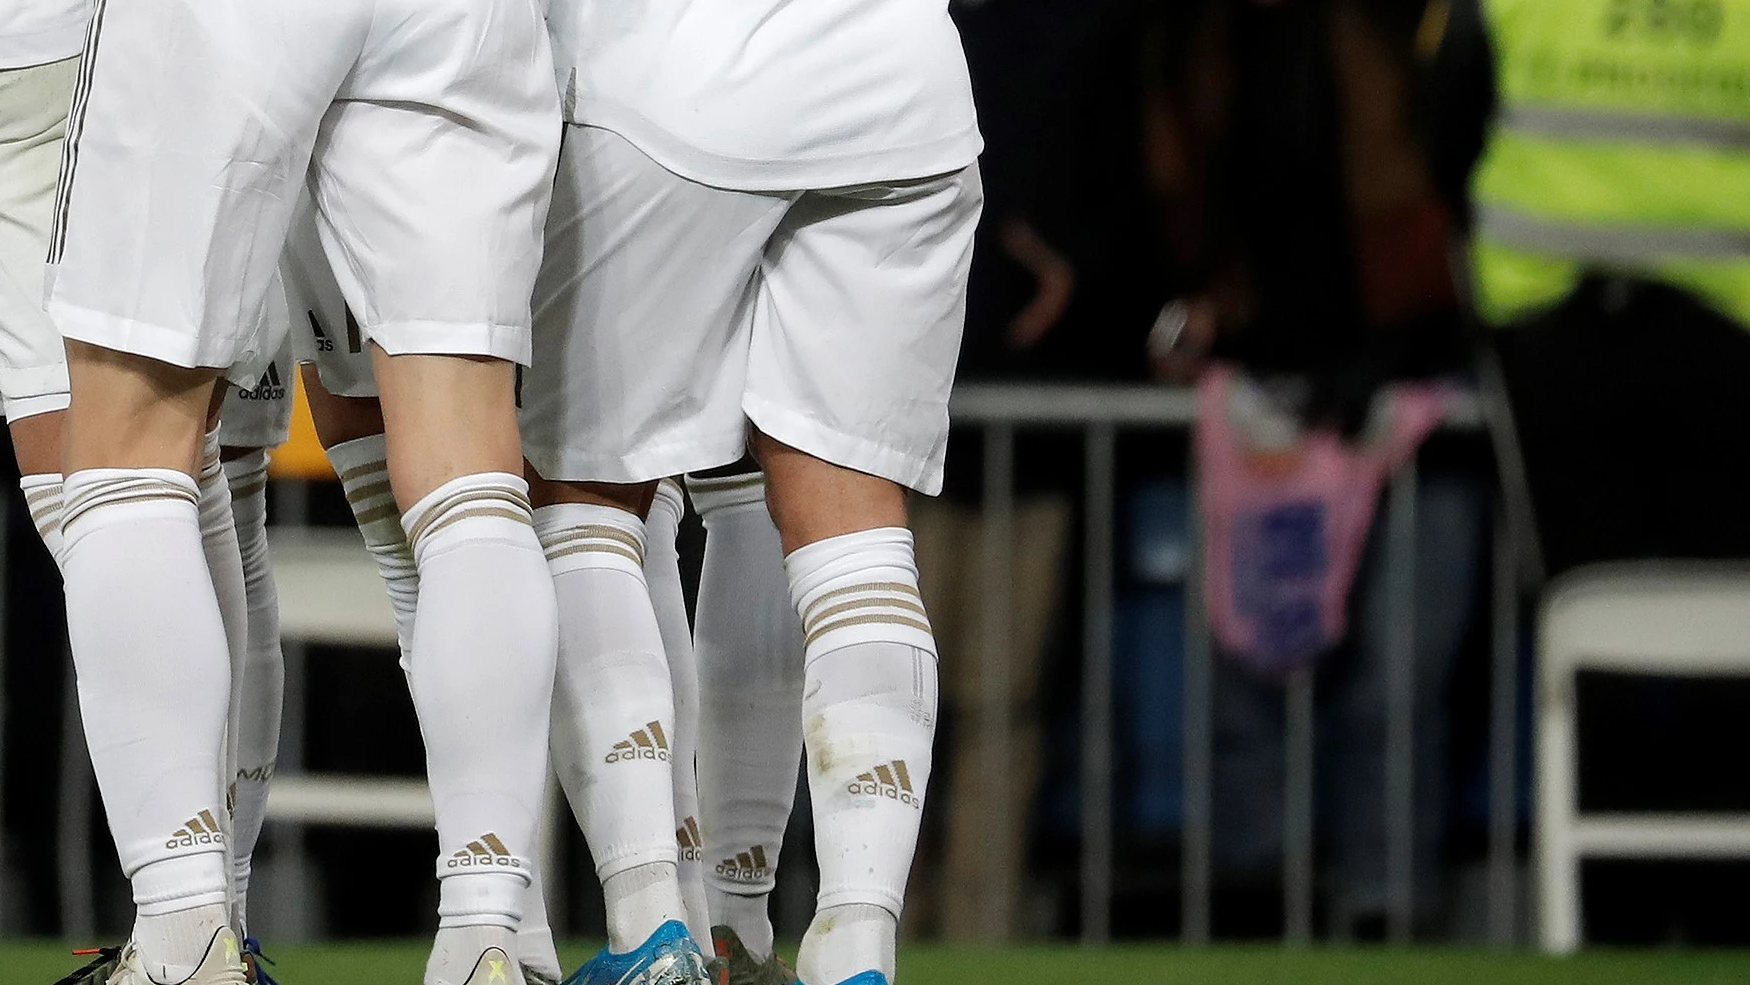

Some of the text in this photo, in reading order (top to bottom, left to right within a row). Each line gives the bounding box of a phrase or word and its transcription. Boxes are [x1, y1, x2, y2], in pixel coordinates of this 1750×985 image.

[238, 384, 286, 402] adidas
[848, 782, 921, 810] adidas
[447, 855, 521, 869] adidas
